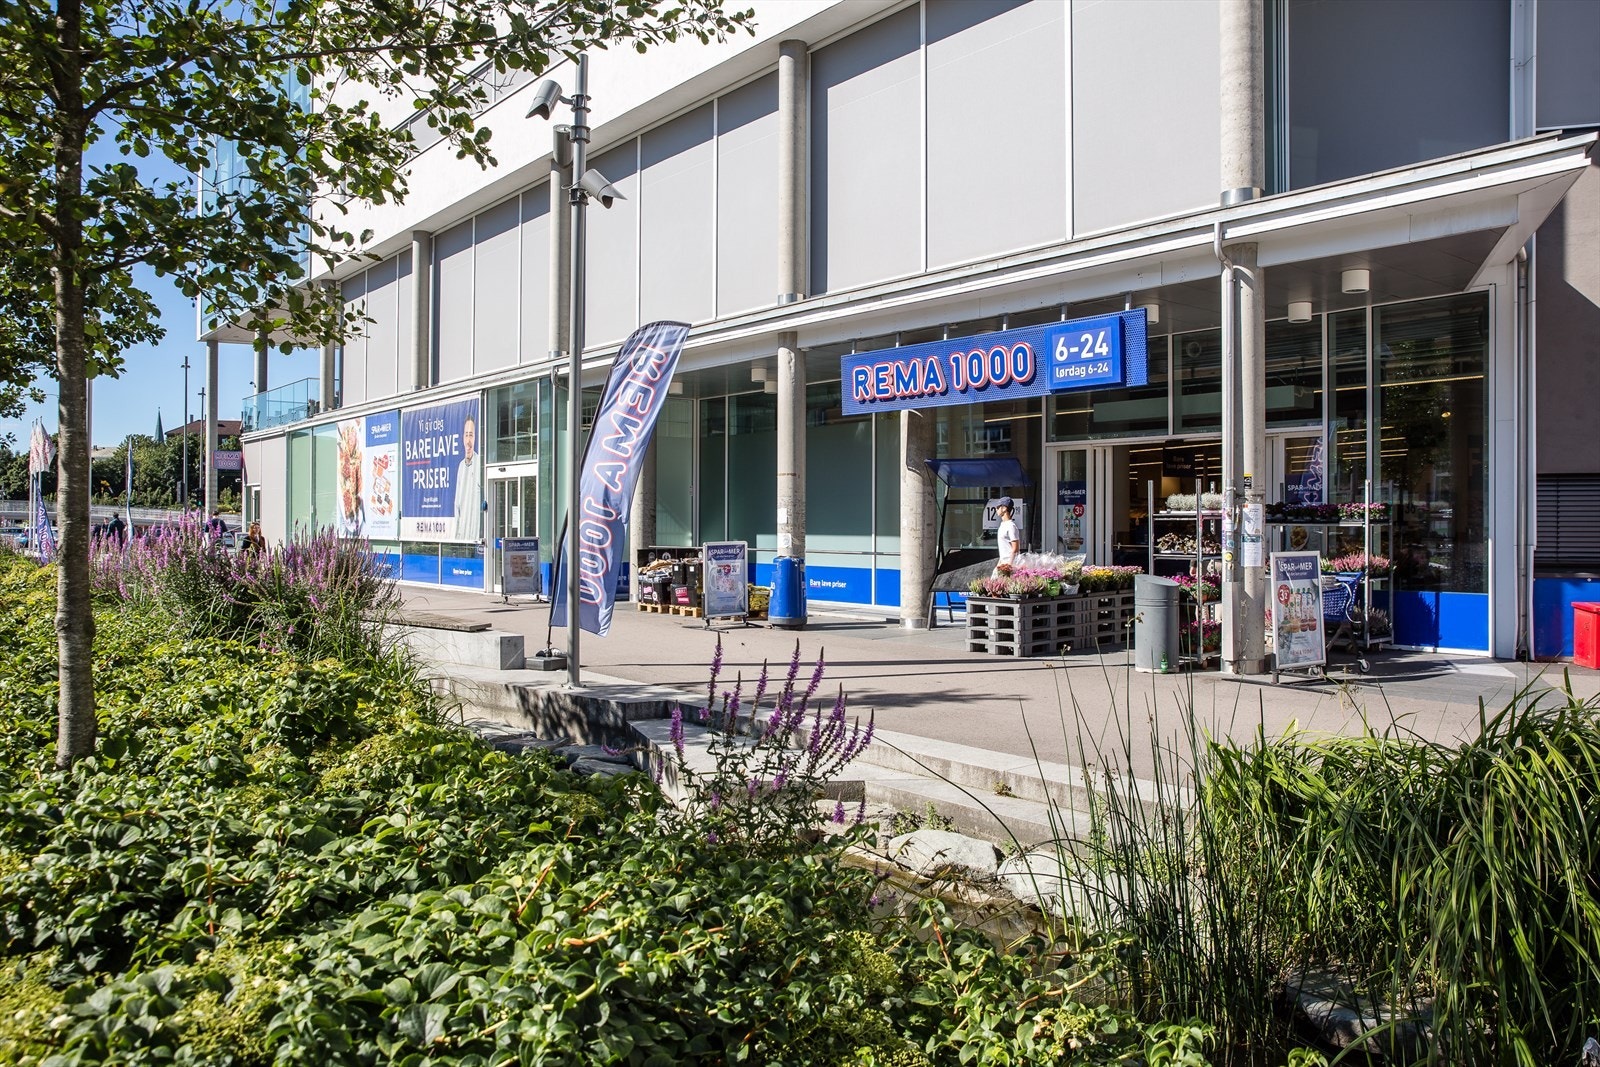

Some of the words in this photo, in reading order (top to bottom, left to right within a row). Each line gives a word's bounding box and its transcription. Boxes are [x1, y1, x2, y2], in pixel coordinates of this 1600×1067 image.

[1055, 330, 1109, 362] 6-24
[853, 356, 946, 400] REMA
[951, 342, 1034, 390] 1000
[1056, 365, 1086, 378] lørdag
[1088, 362, 1109, 374] 6-24
[433, 417, 444, 432] deg
[405, 438, 431, 460] BARE
[432, 433, 459, 457] LAVE
[412, 467, 450, 490] PRISER!
[987, 507, 996, 521] 12
[416, 522, 432, 533] REMA
[433, 522, 446, 533] 1000
[1280, 562, 1295, 571] SPAR
[1299, 562, 1312, 571] MER
[810, 579, 821, 587] Bare
[832, 580, 846, 588] priser
